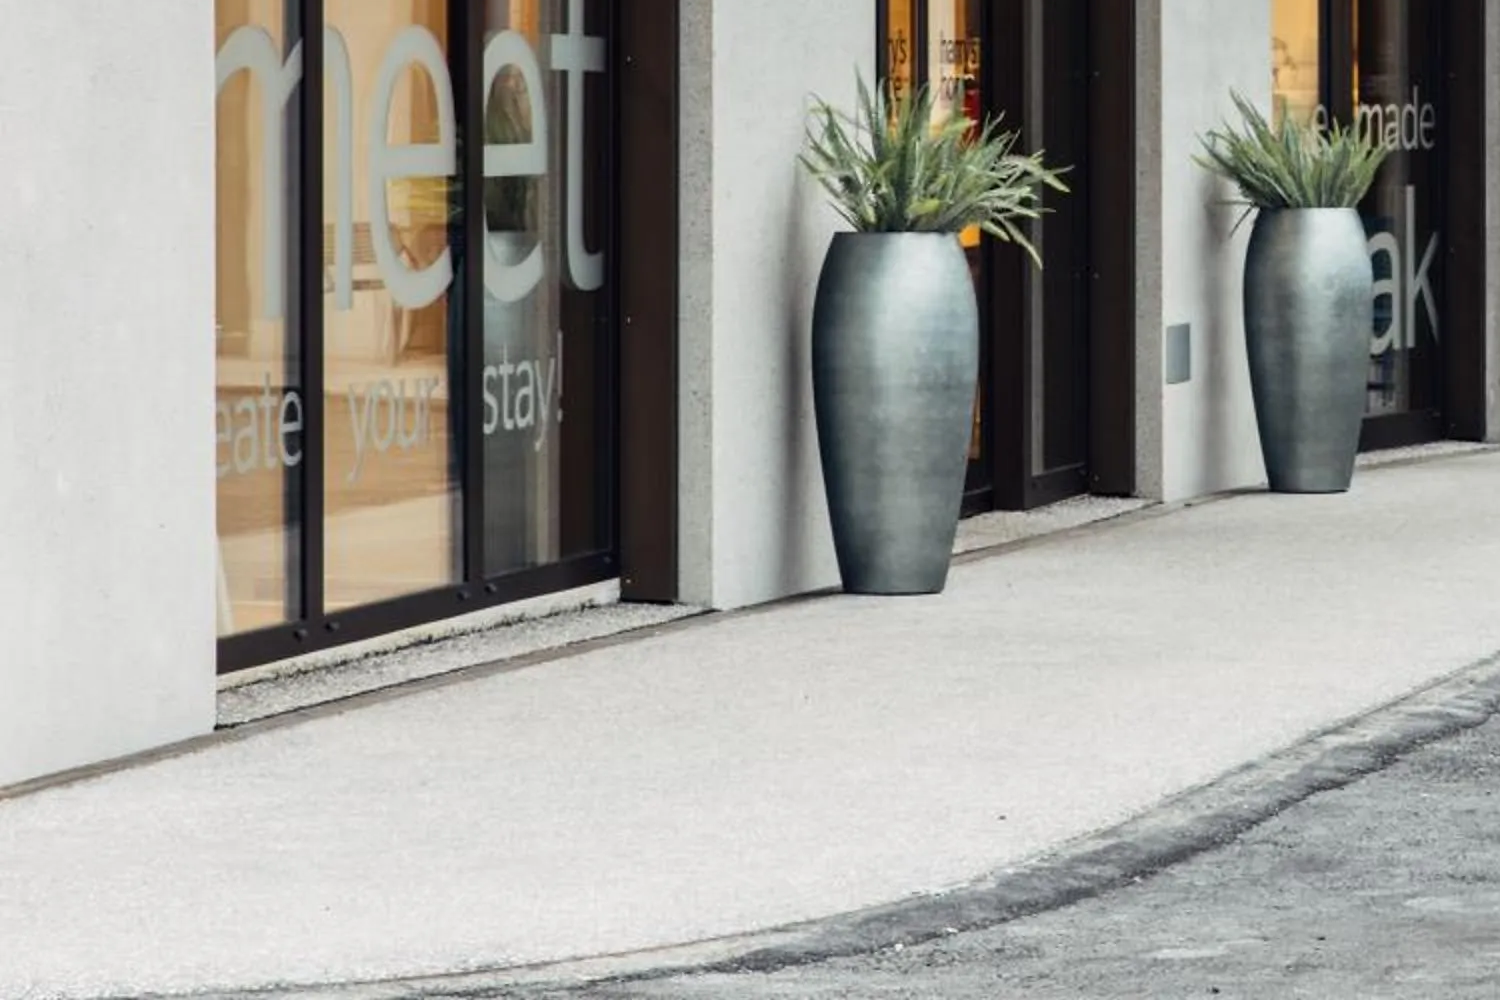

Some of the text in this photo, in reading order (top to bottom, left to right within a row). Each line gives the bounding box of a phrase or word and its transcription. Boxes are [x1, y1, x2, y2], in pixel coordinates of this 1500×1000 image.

[1358, 85, 1437, 150] made
[347, 376, 439, 486] your
[483, 329, 563, 451] stay!
